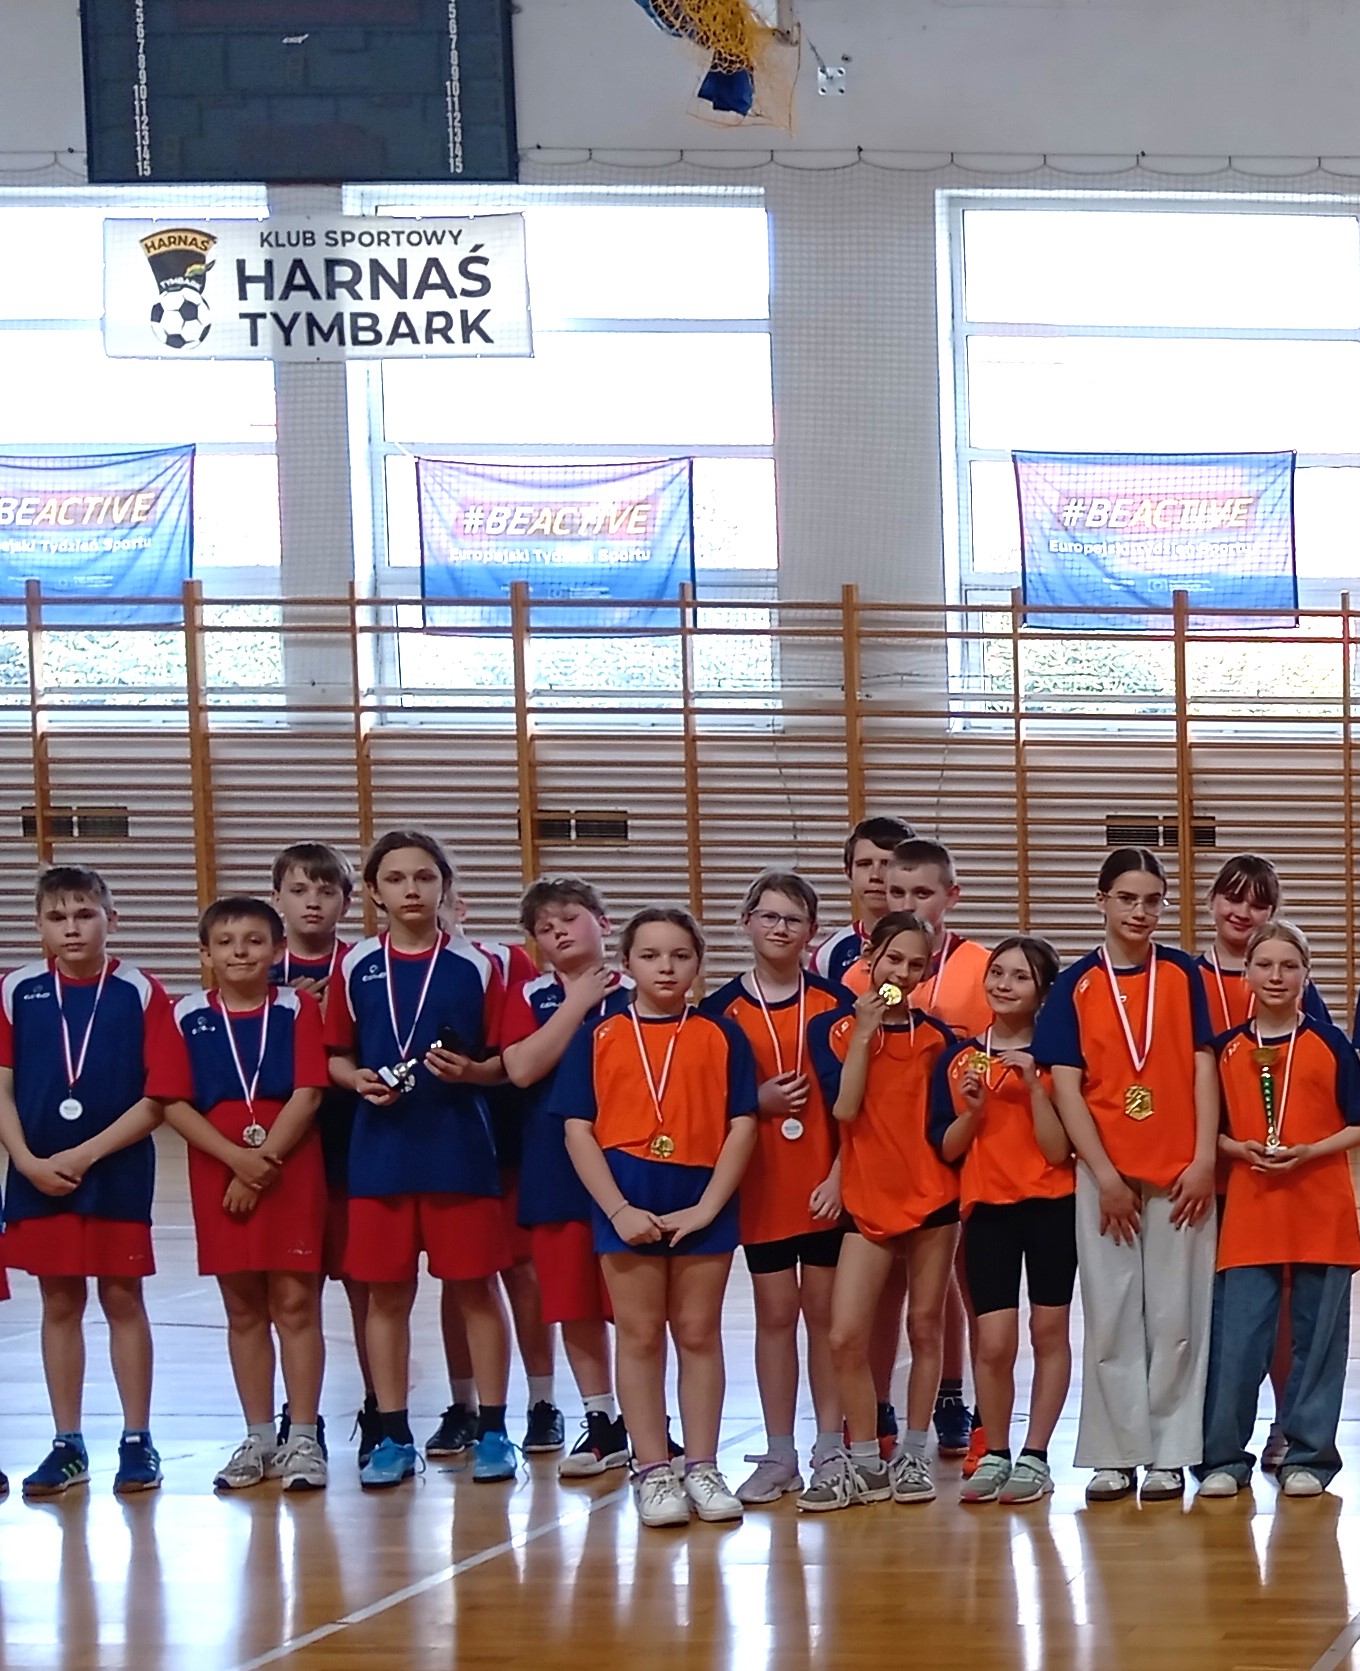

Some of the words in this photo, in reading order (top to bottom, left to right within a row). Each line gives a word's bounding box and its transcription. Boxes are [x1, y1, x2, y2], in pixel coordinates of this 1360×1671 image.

[136, 7, 144, 22] 5
[448, 3, 457, 18] 5
[136, 23, 145, 38] 6
[449, 18, 457, 34] 6
[137, 38, 145, 53] 7
[449, 34, 457, 49] 7
[138, 53, 146, 69] 8
[450, 49, 458, 65] 8
[139, 69, 147, 84] 9
[451, 65, 459, 81] 9
[133, 84, 148, 100] 10
[445, 81, 460, 96] 10
[134, 100, 147, 115] 11
[446, 96, 459, 112] 11
[135, 115, 149, 131] 12
[447, 111, 461, 127] 12
[135, 130, 150, 145] 13
[447, 127, 462, 142] 13
[136, 145, 151, 161] 14
[448, 142, 462, 158] 14
[137, 160, 152, 176] 15
[449, 158, 463, 174] 15
[259, 230, 316, 247] KLUB
[325, 229, 463, 248] SPORTOWY
[236, 244, 492, 301] HARNAŚ
[239, 309, 494, 347] TYMBARK
